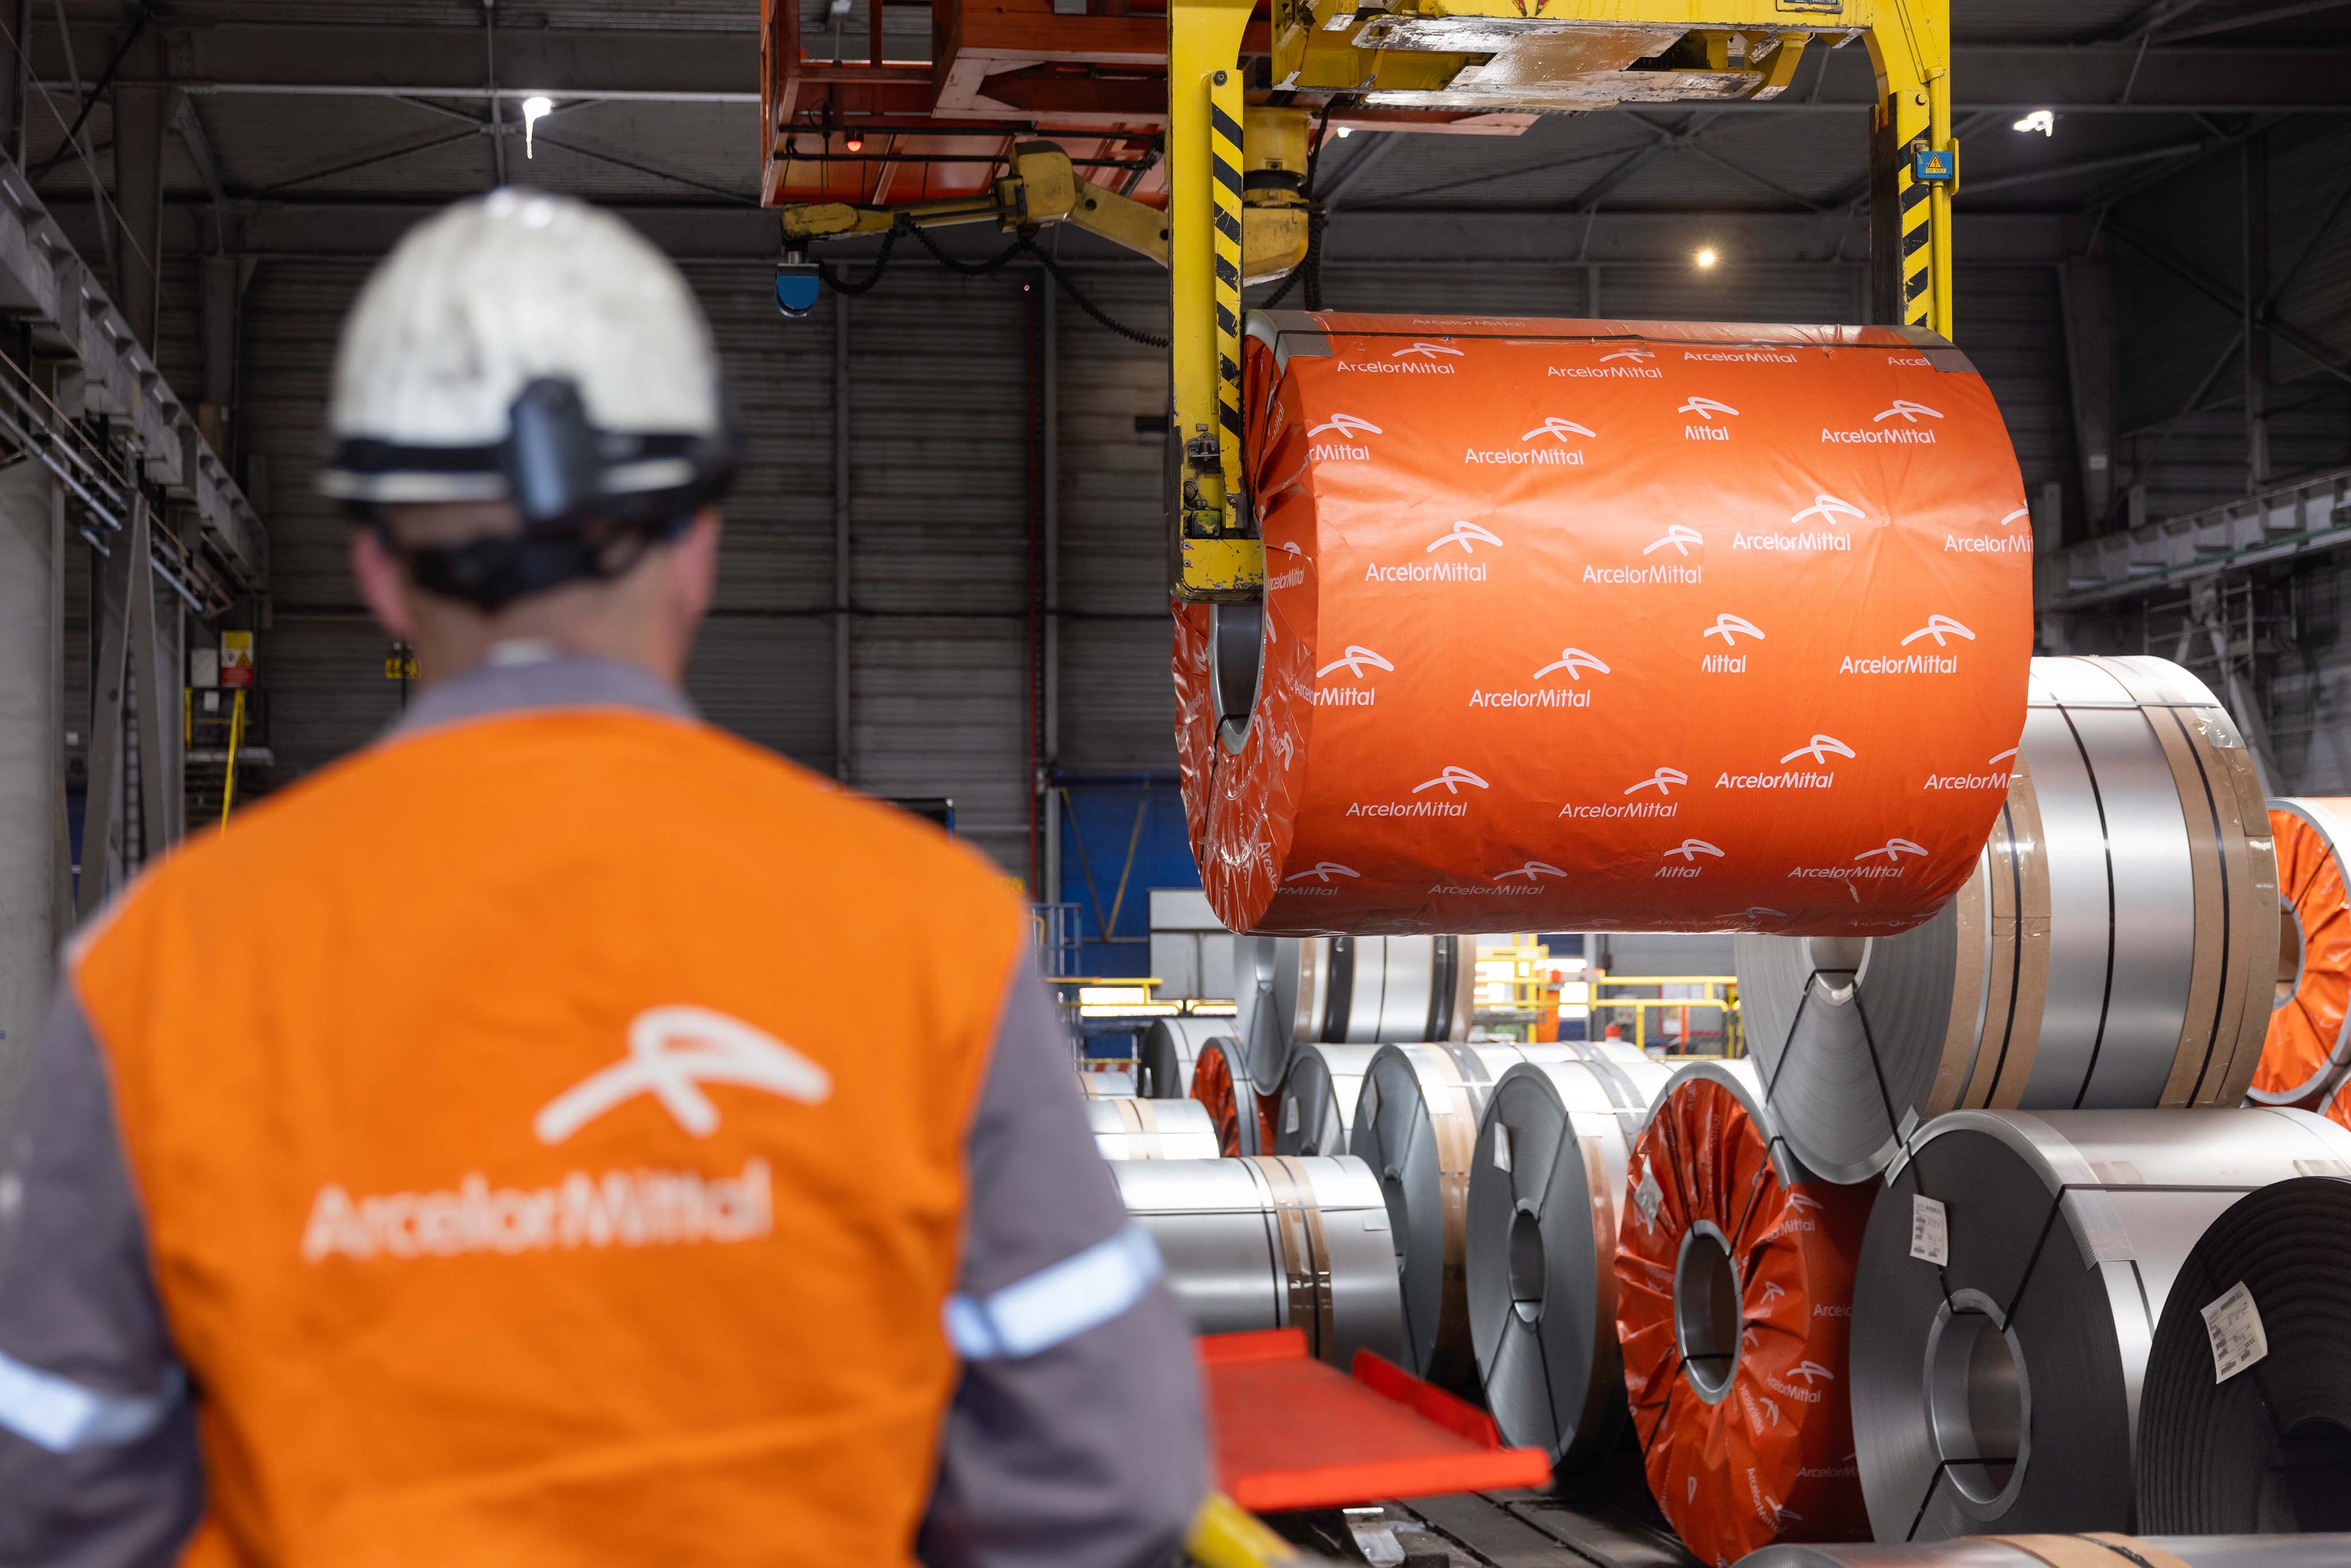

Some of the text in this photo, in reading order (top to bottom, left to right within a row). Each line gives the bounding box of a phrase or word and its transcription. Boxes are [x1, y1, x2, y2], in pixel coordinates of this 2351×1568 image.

[1413, 318, 1526, 327] ArcelorMittal
[1684, 351, 1798, 363] ArcelorMittal
[1337, 360, 1455, 375] ArcelorMittal
[1547, 366, 1663, 379] ArcelorMittal
[1821, 428, 1936, 444] ArcelorMittal
[1465, 448, 1584, 465] ArcelorMittal
[1732, 532, 1850, 552] ArcelorMittal
[1365, 562, 1487, 582] ArcelorMittal
[1582, 565, 1702, 584] ArcelorMittal
[1839, 655, 1957, 674] ArcelorMittal
[1294, 679, 1375, 707] ArcelorMittal
[1469, 688, 1590, 708] ArcelorMittal
[1714, 771, 1834, 789] ArcelorMittal
[1345, 801, 1468, 817] ArcelorMittal
[1558, 802, 1678, 818] ArcelorMittal
[1787, 865, 1905, 878] ArcelorMittal
[1427, 884, 1545, 895] ArcelorMittal
[301, 1158, 773, 1262] ArcelorMittal
